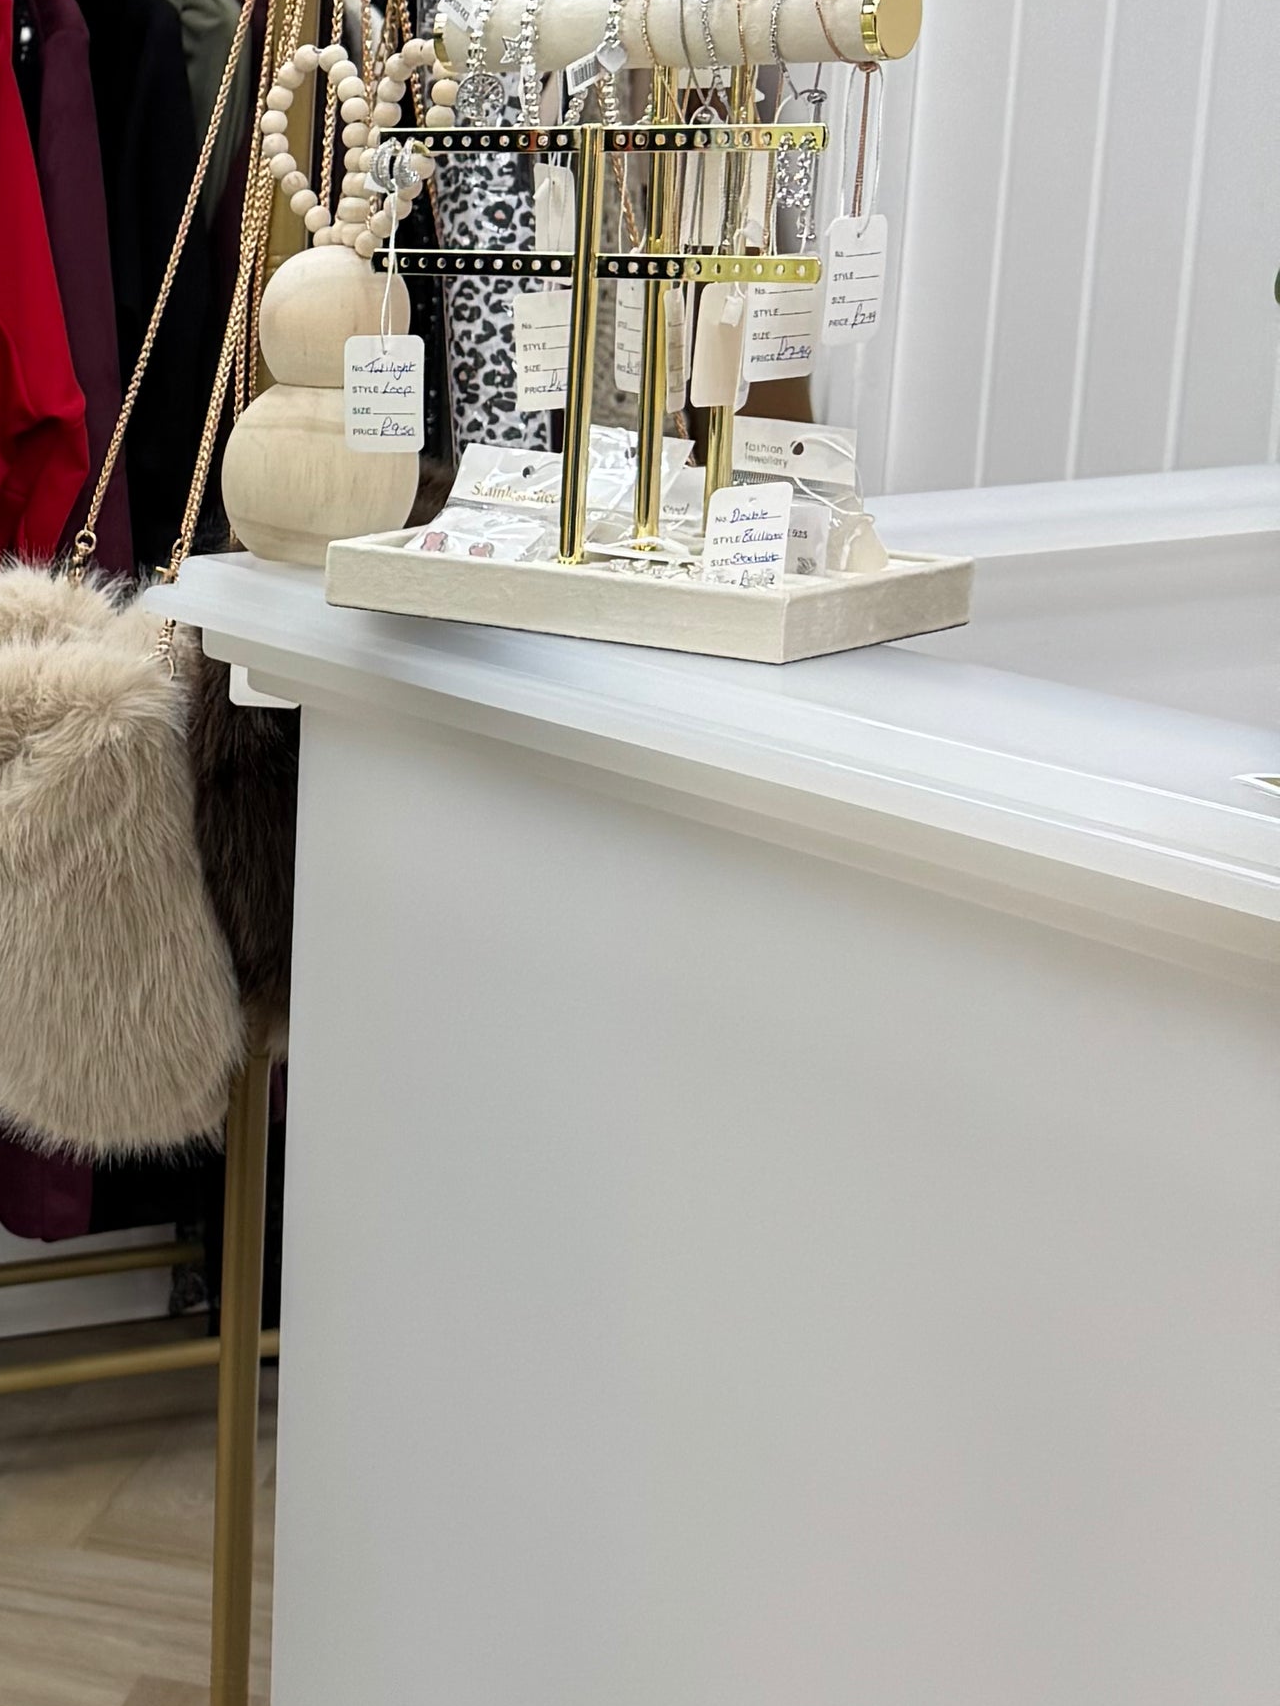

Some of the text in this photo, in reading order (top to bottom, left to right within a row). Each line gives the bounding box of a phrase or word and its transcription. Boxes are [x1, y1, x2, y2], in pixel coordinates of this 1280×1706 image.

[833, 271, 854, 282] STYLE
[752, 308, 779, 318] STYLE
[751, 331, 771, 341] SIZE
[522, 342, 547, 351] STYLE
[750, 353, 775, 363] PRICE
[523, 364, 542, 373] SIZE
[351, 385, 379, 394] STYLE
[524, 385, 547, 394] PRICE
[351, 406, 372, 415] SIZE
[352, 428, 379, 436] PRICE
[744, 441, 784, 455] fashion
[712, 536, 741, 545] STYLE
[710, 558, 732, 568] SIZE
